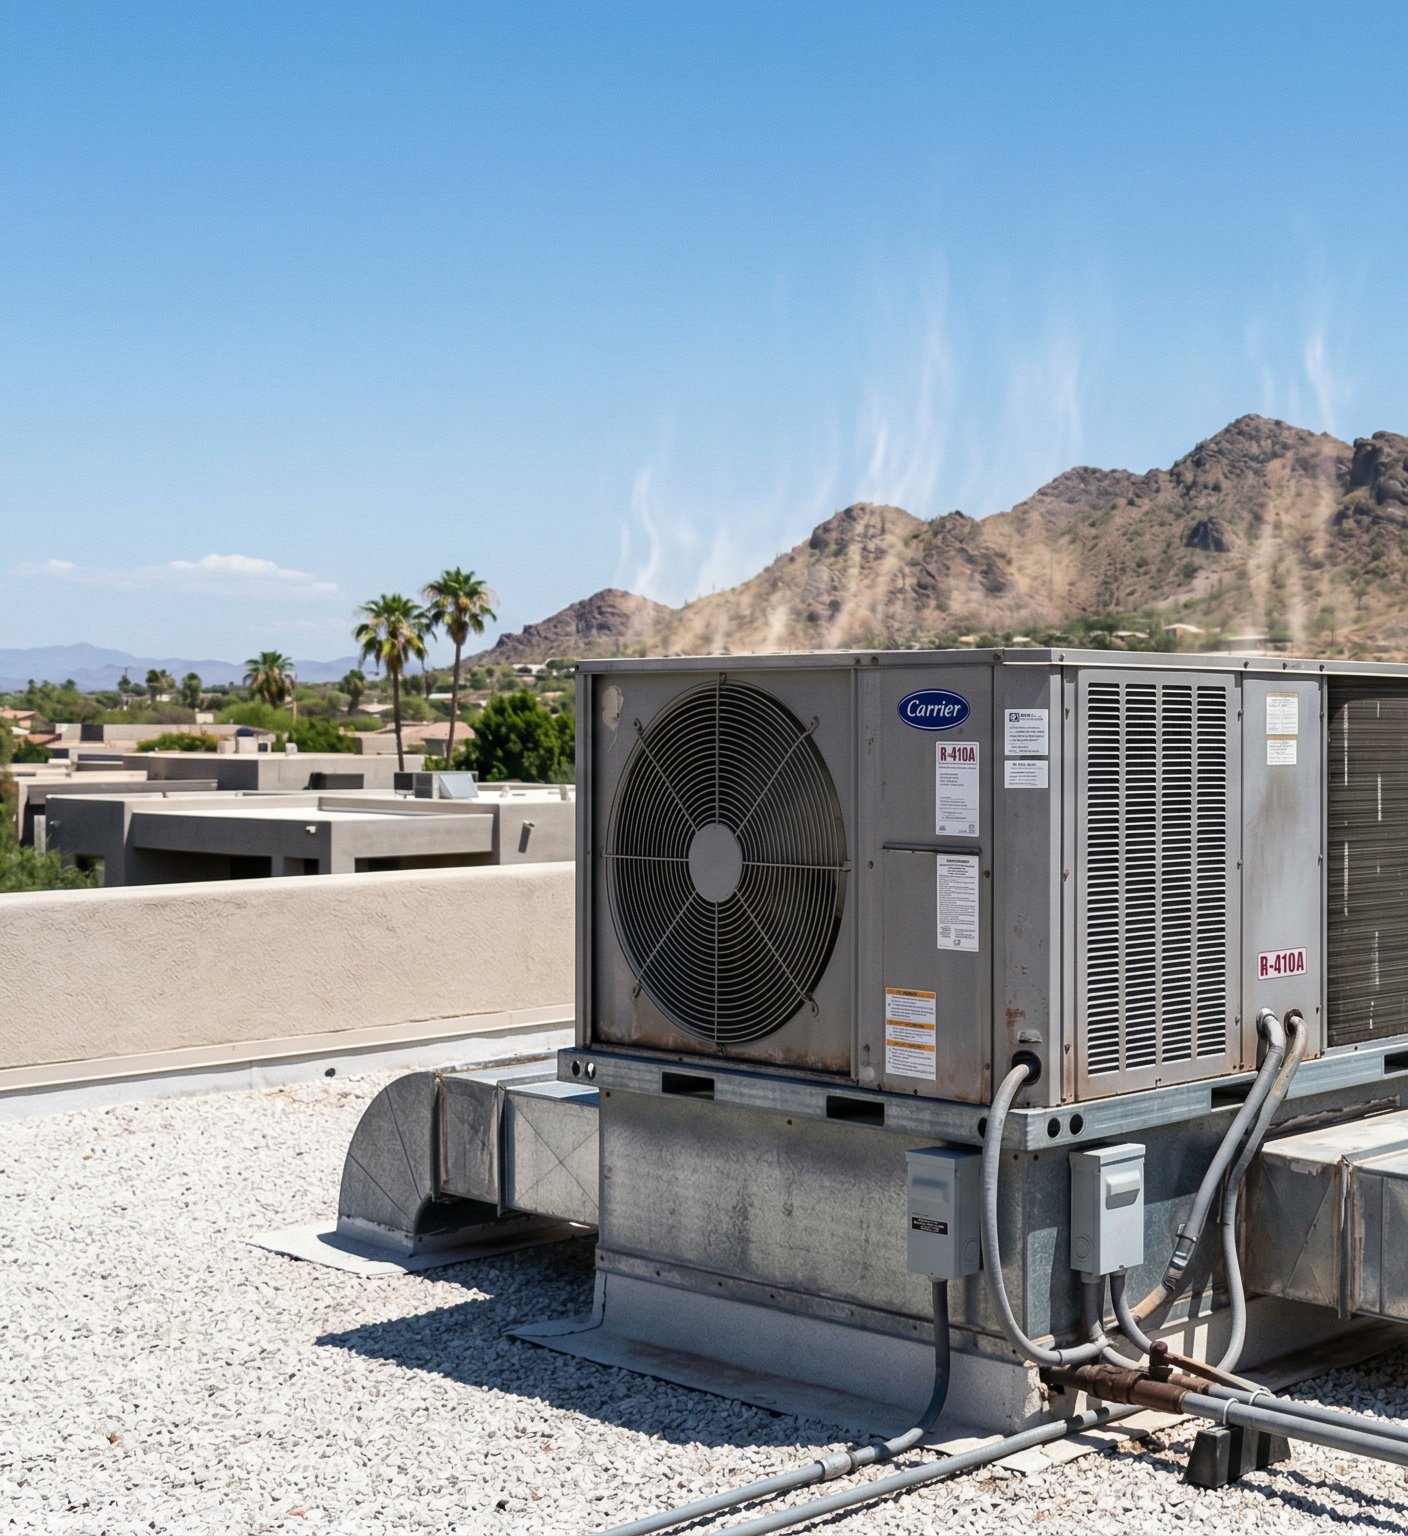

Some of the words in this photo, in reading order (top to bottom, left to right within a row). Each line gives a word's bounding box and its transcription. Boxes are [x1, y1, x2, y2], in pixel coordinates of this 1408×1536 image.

[907, 699, 961, 717] Carrier
[940, 746, 975, 762] R-410A
[1260, 951, 1304, 976] R-410A
